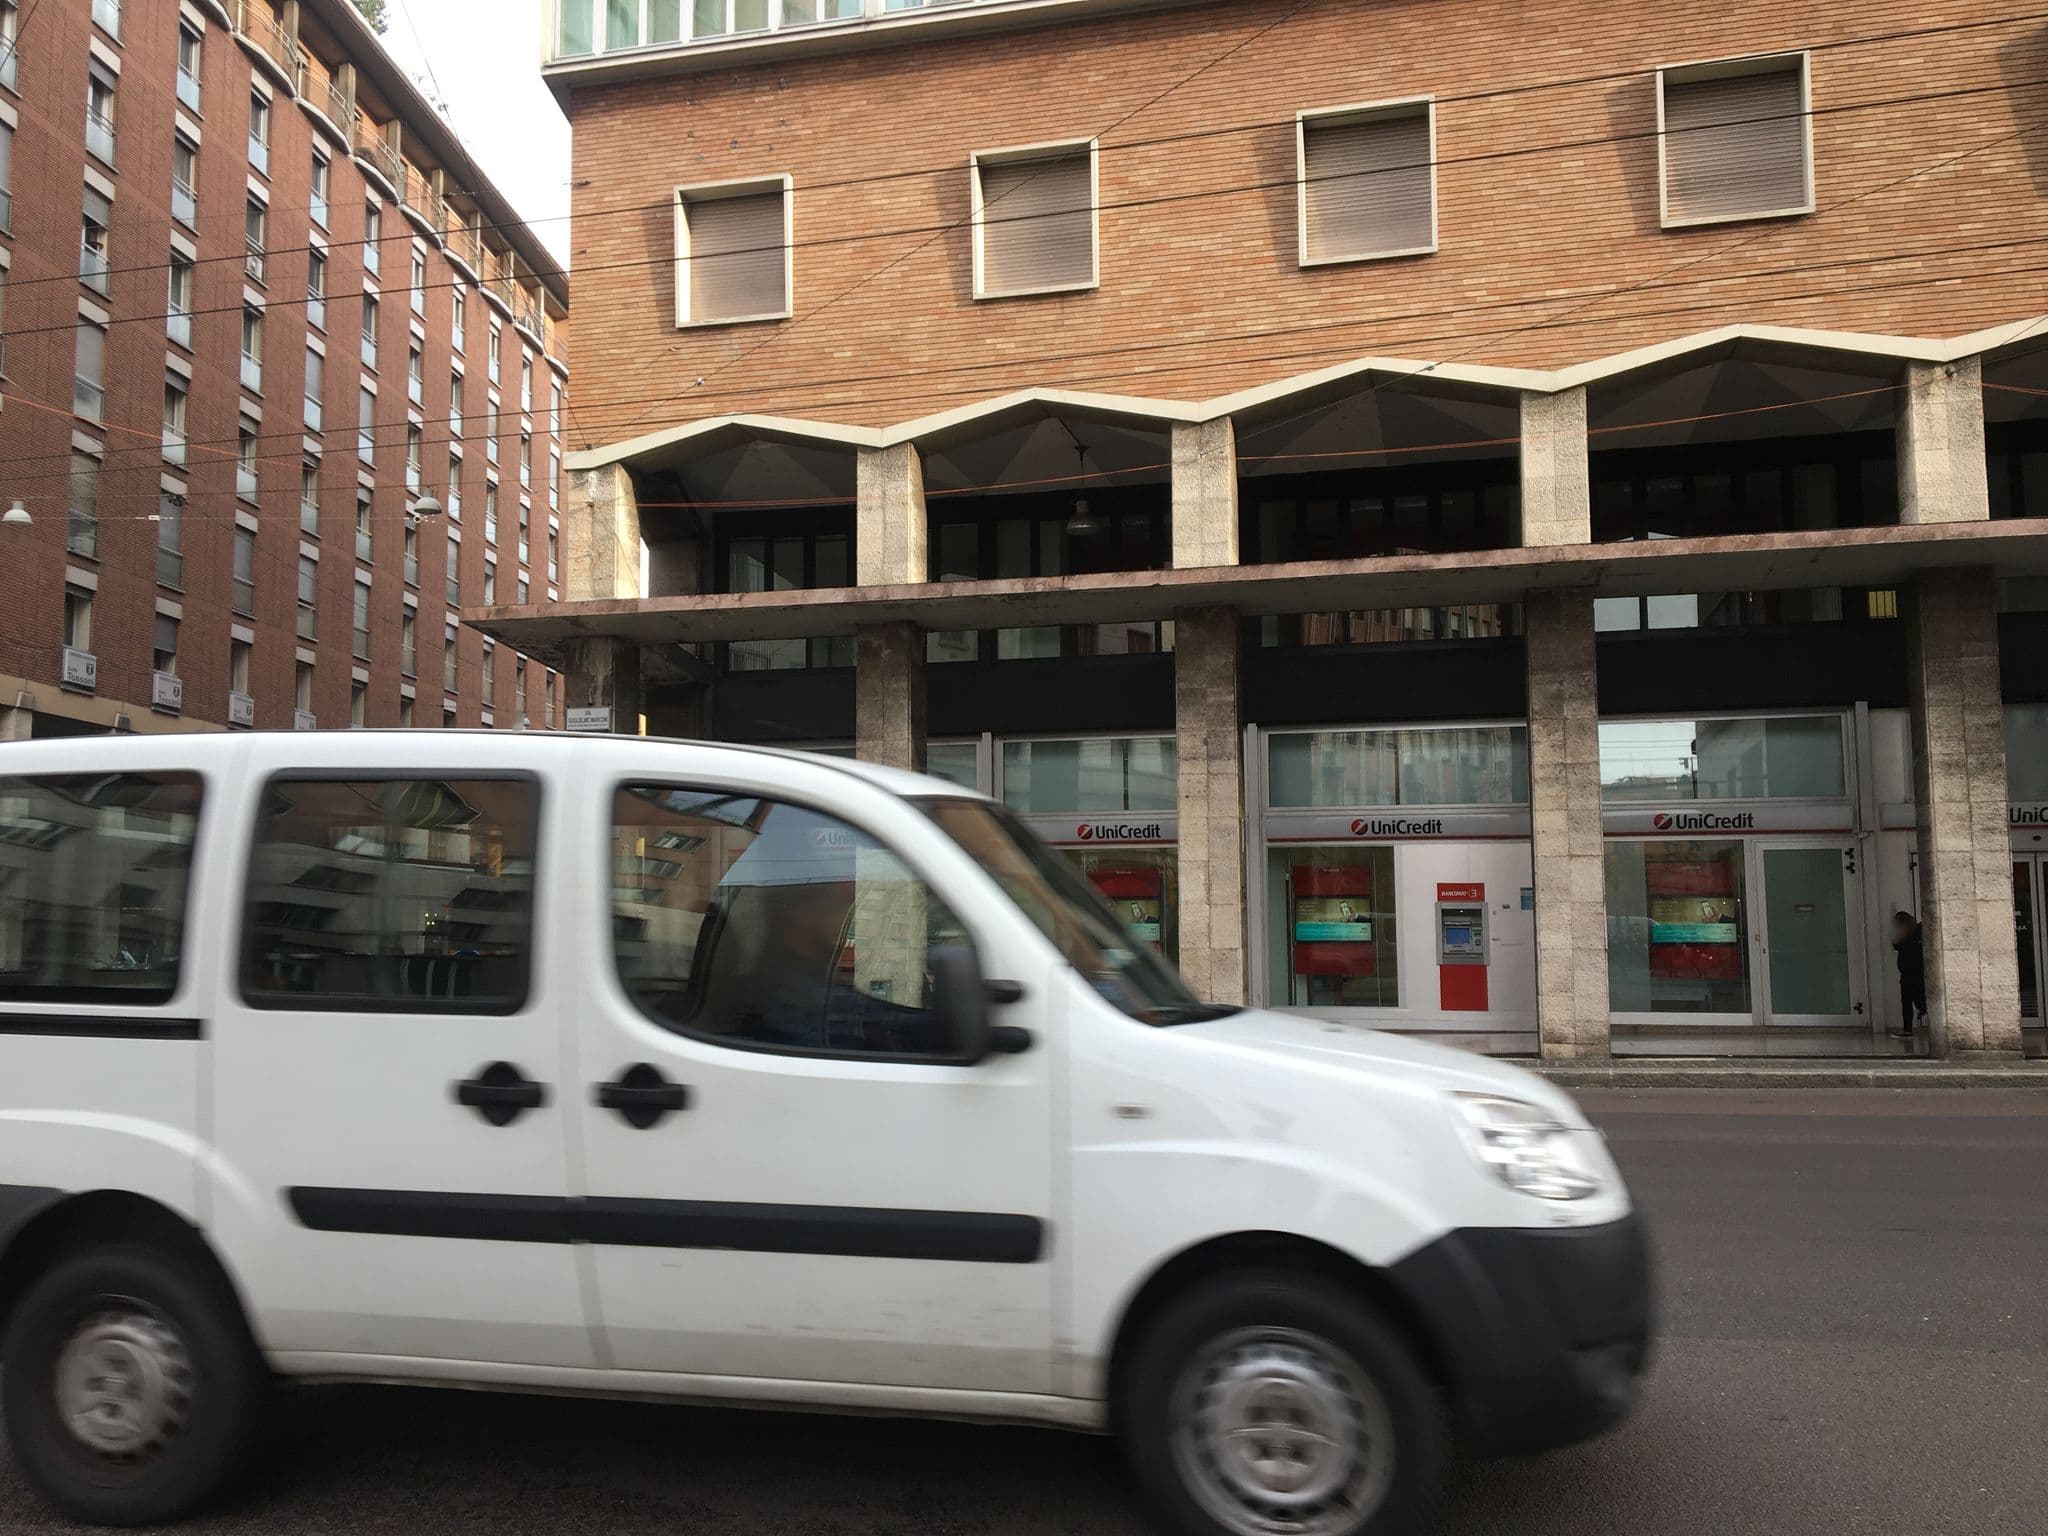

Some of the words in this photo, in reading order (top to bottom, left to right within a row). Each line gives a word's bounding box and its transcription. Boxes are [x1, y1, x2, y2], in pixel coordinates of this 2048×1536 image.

[1371, 819, 1443, 834] UniCredit
[1676, 813, 1754, 829] UniCredit
[828, 831, 853, 845] Uni
[1096, 823, 1161, 839] UniCredit
